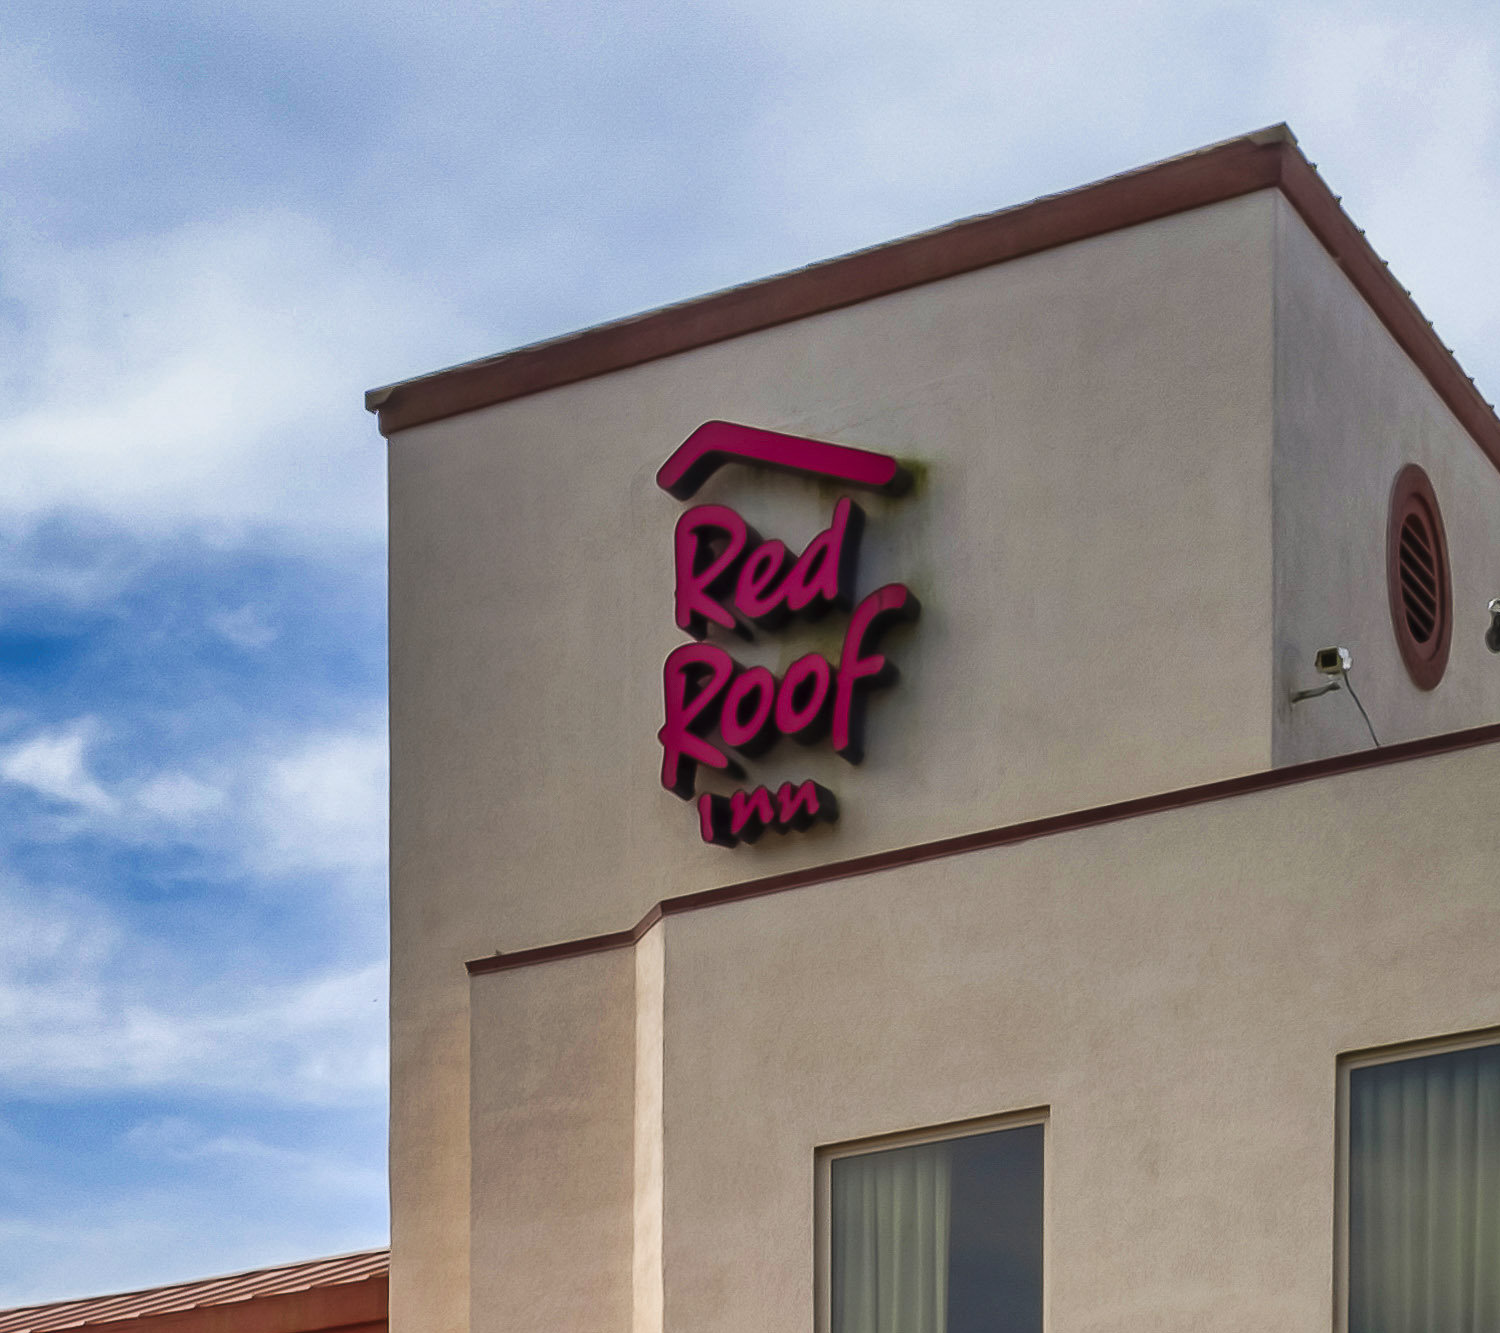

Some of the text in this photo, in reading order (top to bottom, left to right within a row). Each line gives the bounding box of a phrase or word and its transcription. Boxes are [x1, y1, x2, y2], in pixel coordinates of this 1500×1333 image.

[674, 497, 858, 632] Red
[657, 583, 910, 791] Roof
[698, 779, 828, 844] Inn
